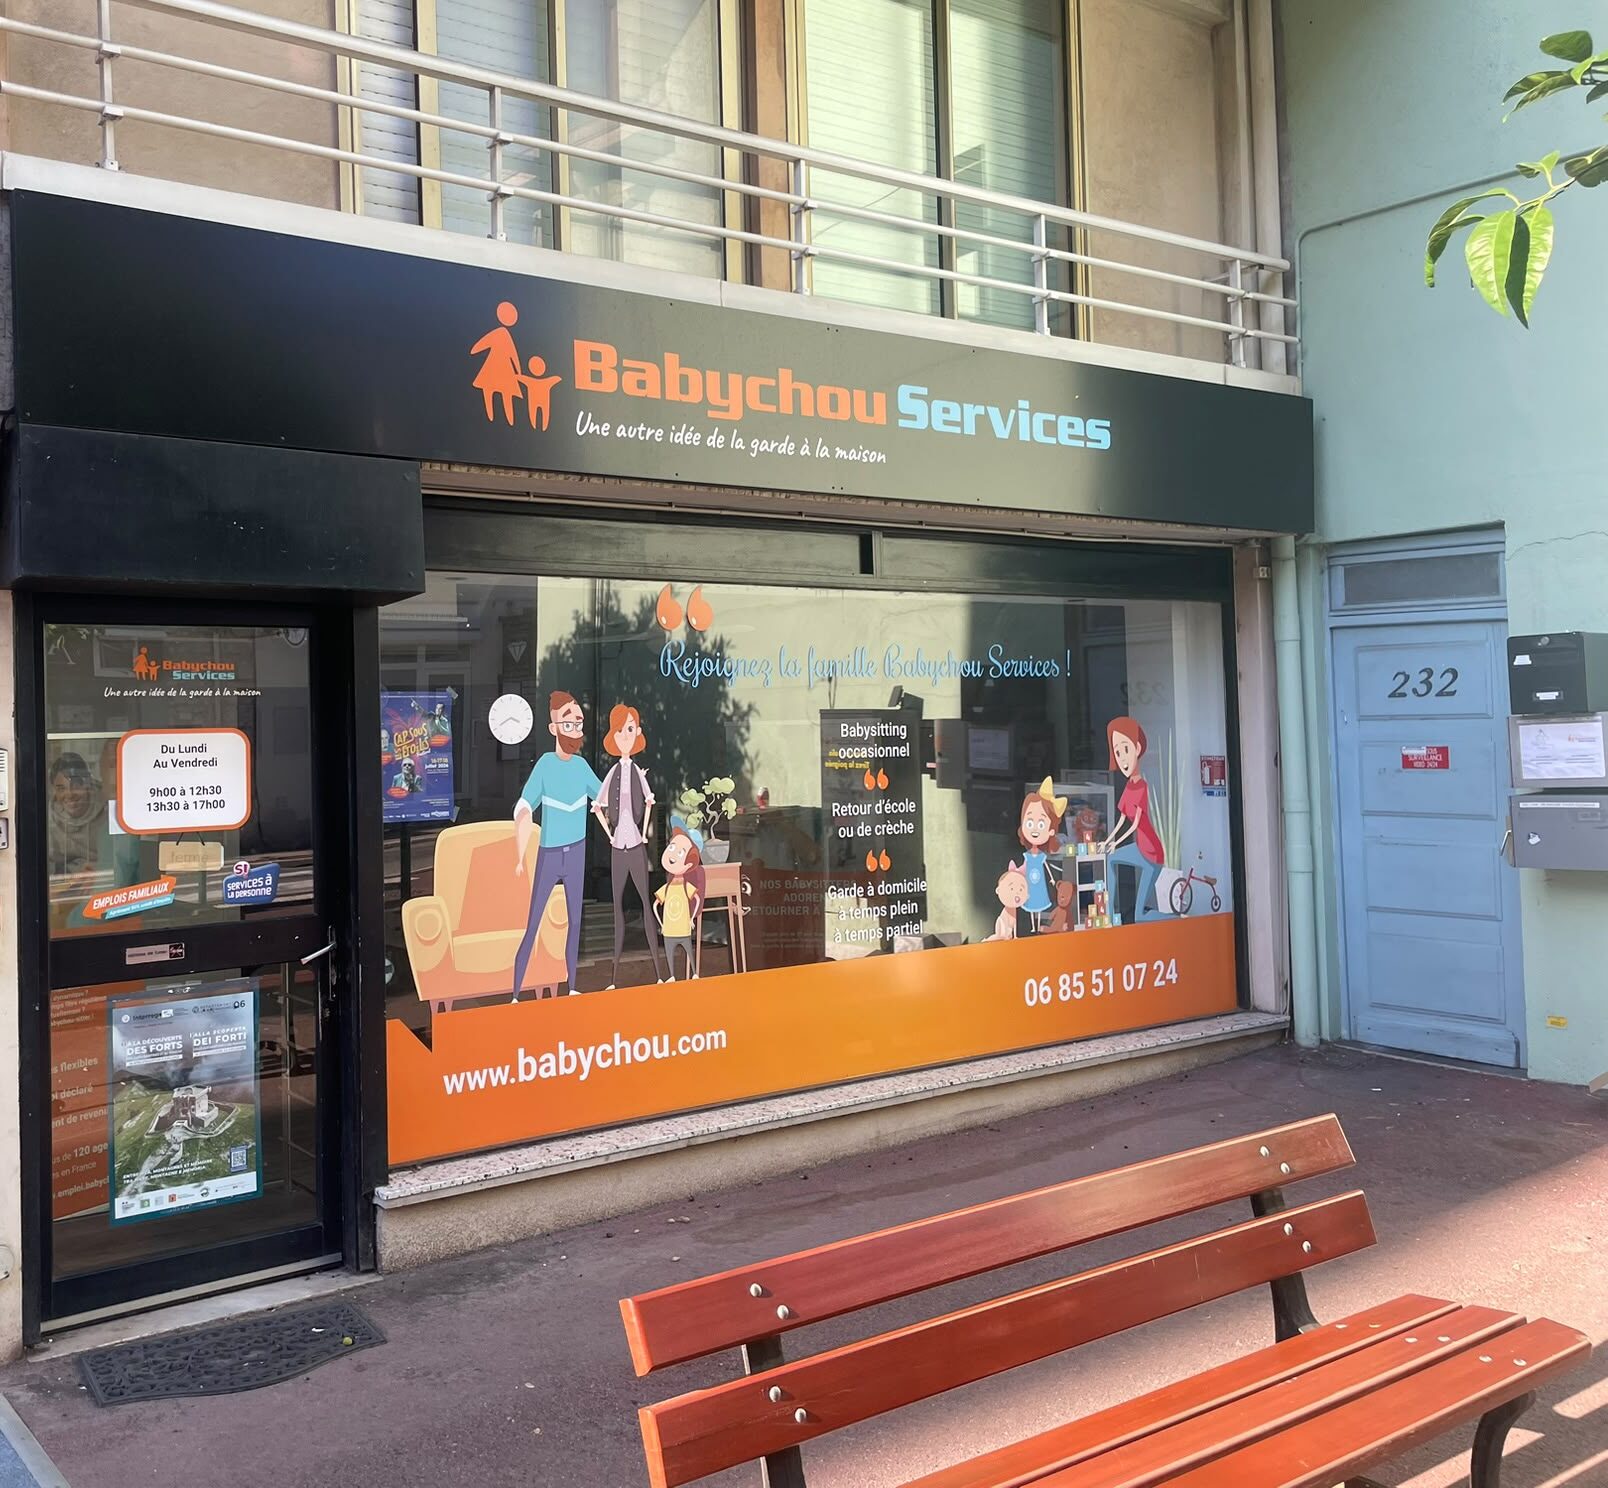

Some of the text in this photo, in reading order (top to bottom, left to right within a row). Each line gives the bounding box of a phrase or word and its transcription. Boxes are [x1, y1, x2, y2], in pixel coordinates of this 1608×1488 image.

[574, 339, 1111, 450] Babychou Services
[575, 410, 886, 464] Une autre idée de la garde à la maison
[162, 660, 235, 672] Babychou
[659, 639, 1071, 690] Rejoignez la famille Babychou Services !
[172, 670, 235, 680] Services
[1387, 667, 1458, 698] 232
[104, 687, 262, 698] Une autre idée de la garde à la maison
[840, 722, 907, 740] Babysitting
[161, 743, 207, 754] Du Lundi
[838, 742, 910, 759] occasionnel
[153, 757, 218, 768] Au Vendredi
[149, 785, 222, 797] 9h00 à 12h30
[147, 799, 226, 812] 13h30 à 17h00
[832, 798, 916, 817] Retour d'école
[838, 819, 915, 838] ou de crèche
[760, 880, 781, 889] NOS
[827, 877, 928, 900] Garde à domicile
[93, 893, 127, 910] EMPLOIS
[128, 881, 170, 901] FAMILIAUX
[838, 900, 918, 920] à temps plein
[834, 927, 843, 943] à
[845, 927, 883, 943] temps
[886, 918, 923, 940] partiel
[1024, 958, 1178, 1007] 06 85 51 07 24
[126, 1046, 148, 1056] DES
[149, 1040, 183, 1053] FORTS
[193, 1032, 247, 1047] DEI FORTI
[442, 1029, 727, 1095] www.babychou.com
[73, 1145, 91, 1158] 120
